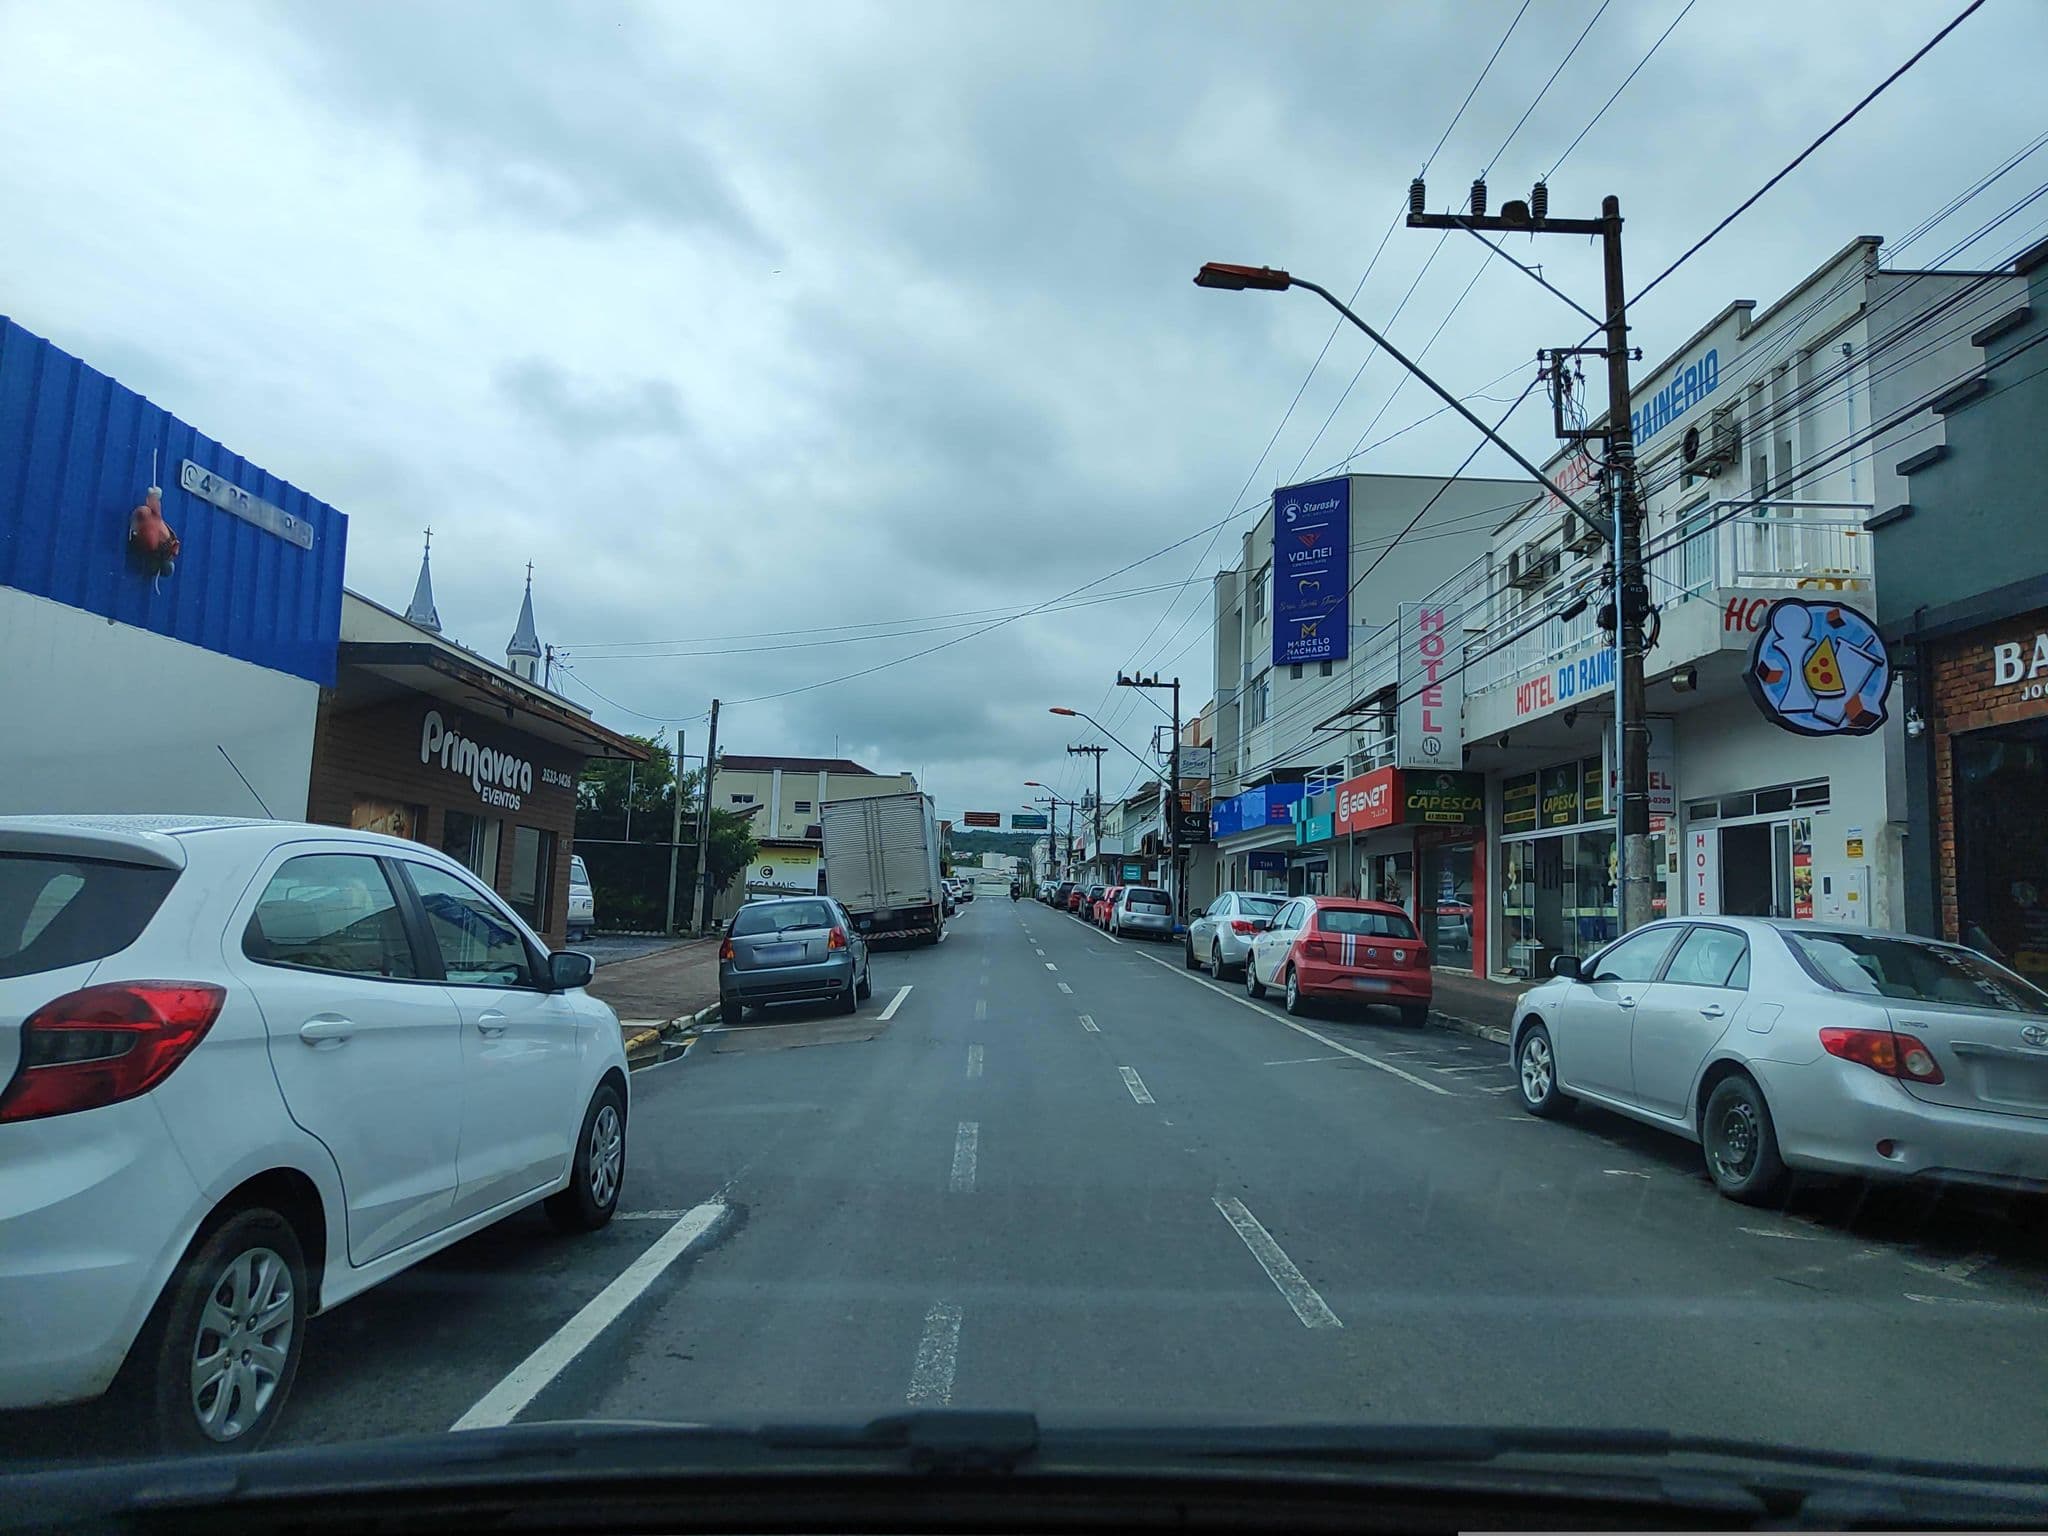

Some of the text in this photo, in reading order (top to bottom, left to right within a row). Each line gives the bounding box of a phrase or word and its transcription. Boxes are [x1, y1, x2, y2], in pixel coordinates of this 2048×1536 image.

[1302, 498, 1341, 513] Starosky
[1287, 637, 1330, 649] MARCELO
[1287, 645, 1331, 656] MACHADO
[1419, 608, 1445, 733] HOTEL
[1516, 674, 1555, 716] HOTEL
[1558, 664, 1575, 701] DO
[421, 710, 533, 795] Primavera
[482, 786, 522, 811] EVENTOS
[1407, 795, 1482, 811] CAPESCA
